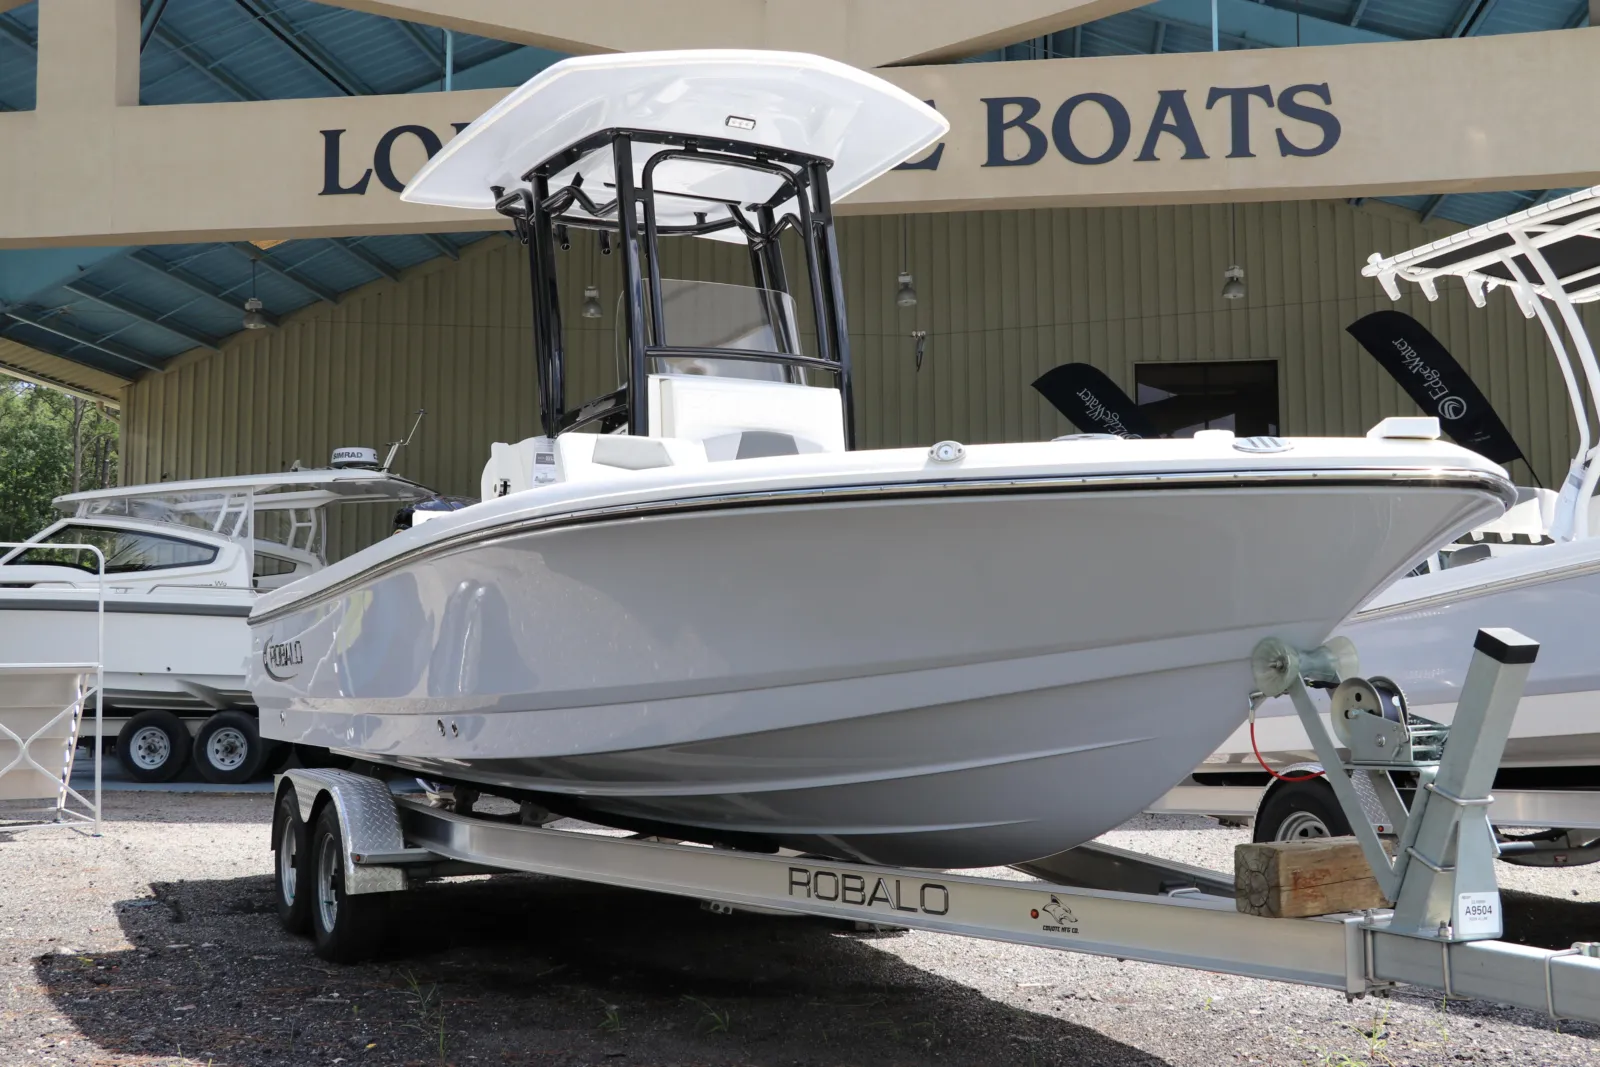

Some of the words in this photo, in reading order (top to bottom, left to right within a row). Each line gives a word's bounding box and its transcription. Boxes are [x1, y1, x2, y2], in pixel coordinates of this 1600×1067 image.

[979, 82, 1342, 168] BOATS
[1391, 337, 1449, 401] EdgeWater
[333, 451, 363, 460] SIMRAD
[788, 866, 949, 915] ROBALO
[1465, 905, 1492, 915] A9504
